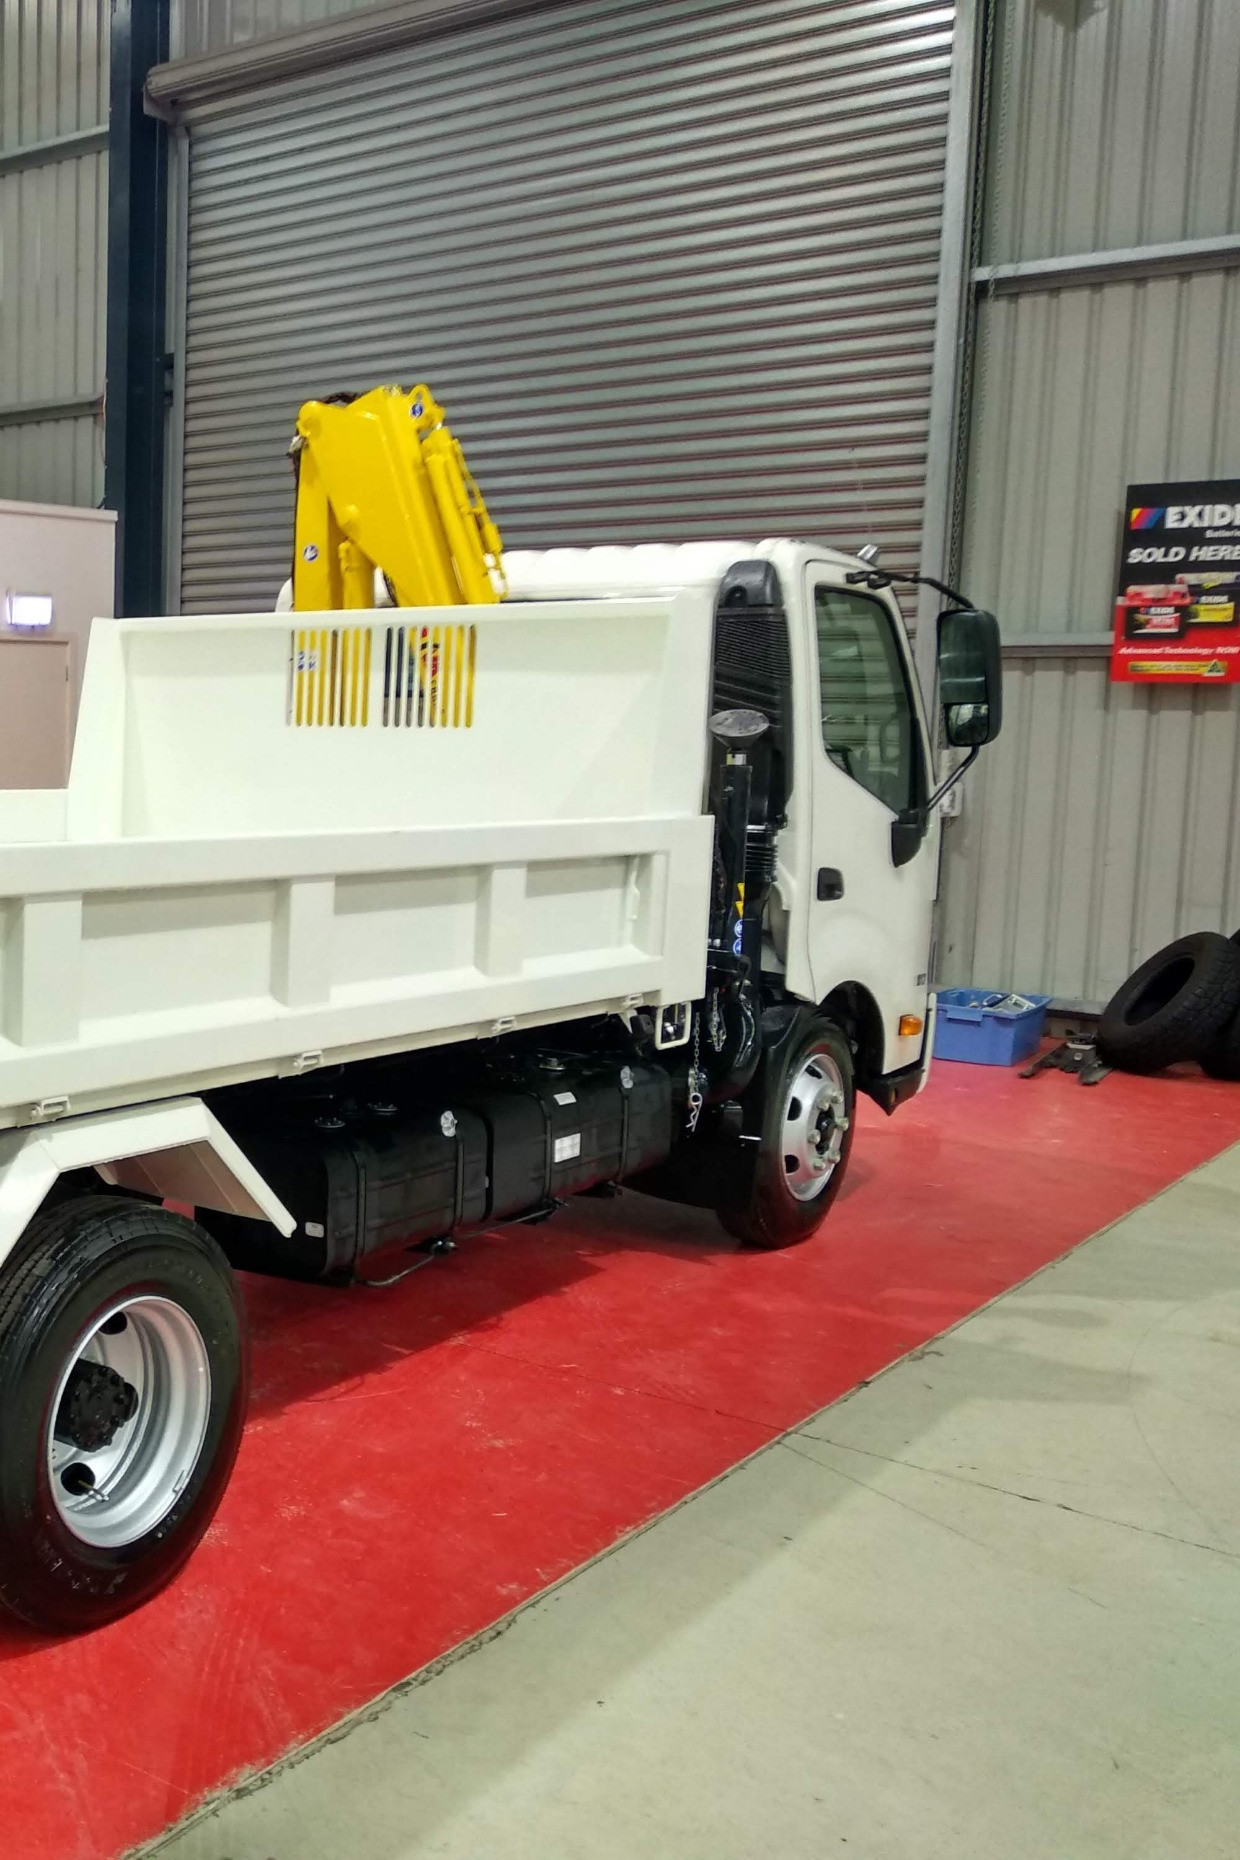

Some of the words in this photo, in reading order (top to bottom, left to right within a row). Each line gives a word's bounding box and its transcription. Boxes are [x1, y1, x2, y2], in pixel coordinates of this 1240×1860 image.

[1128, 546, 1186, 563] SOLD
[1189, 545, 1240, 562] HERE
[1118, 647, 1163, 655] Advanced
